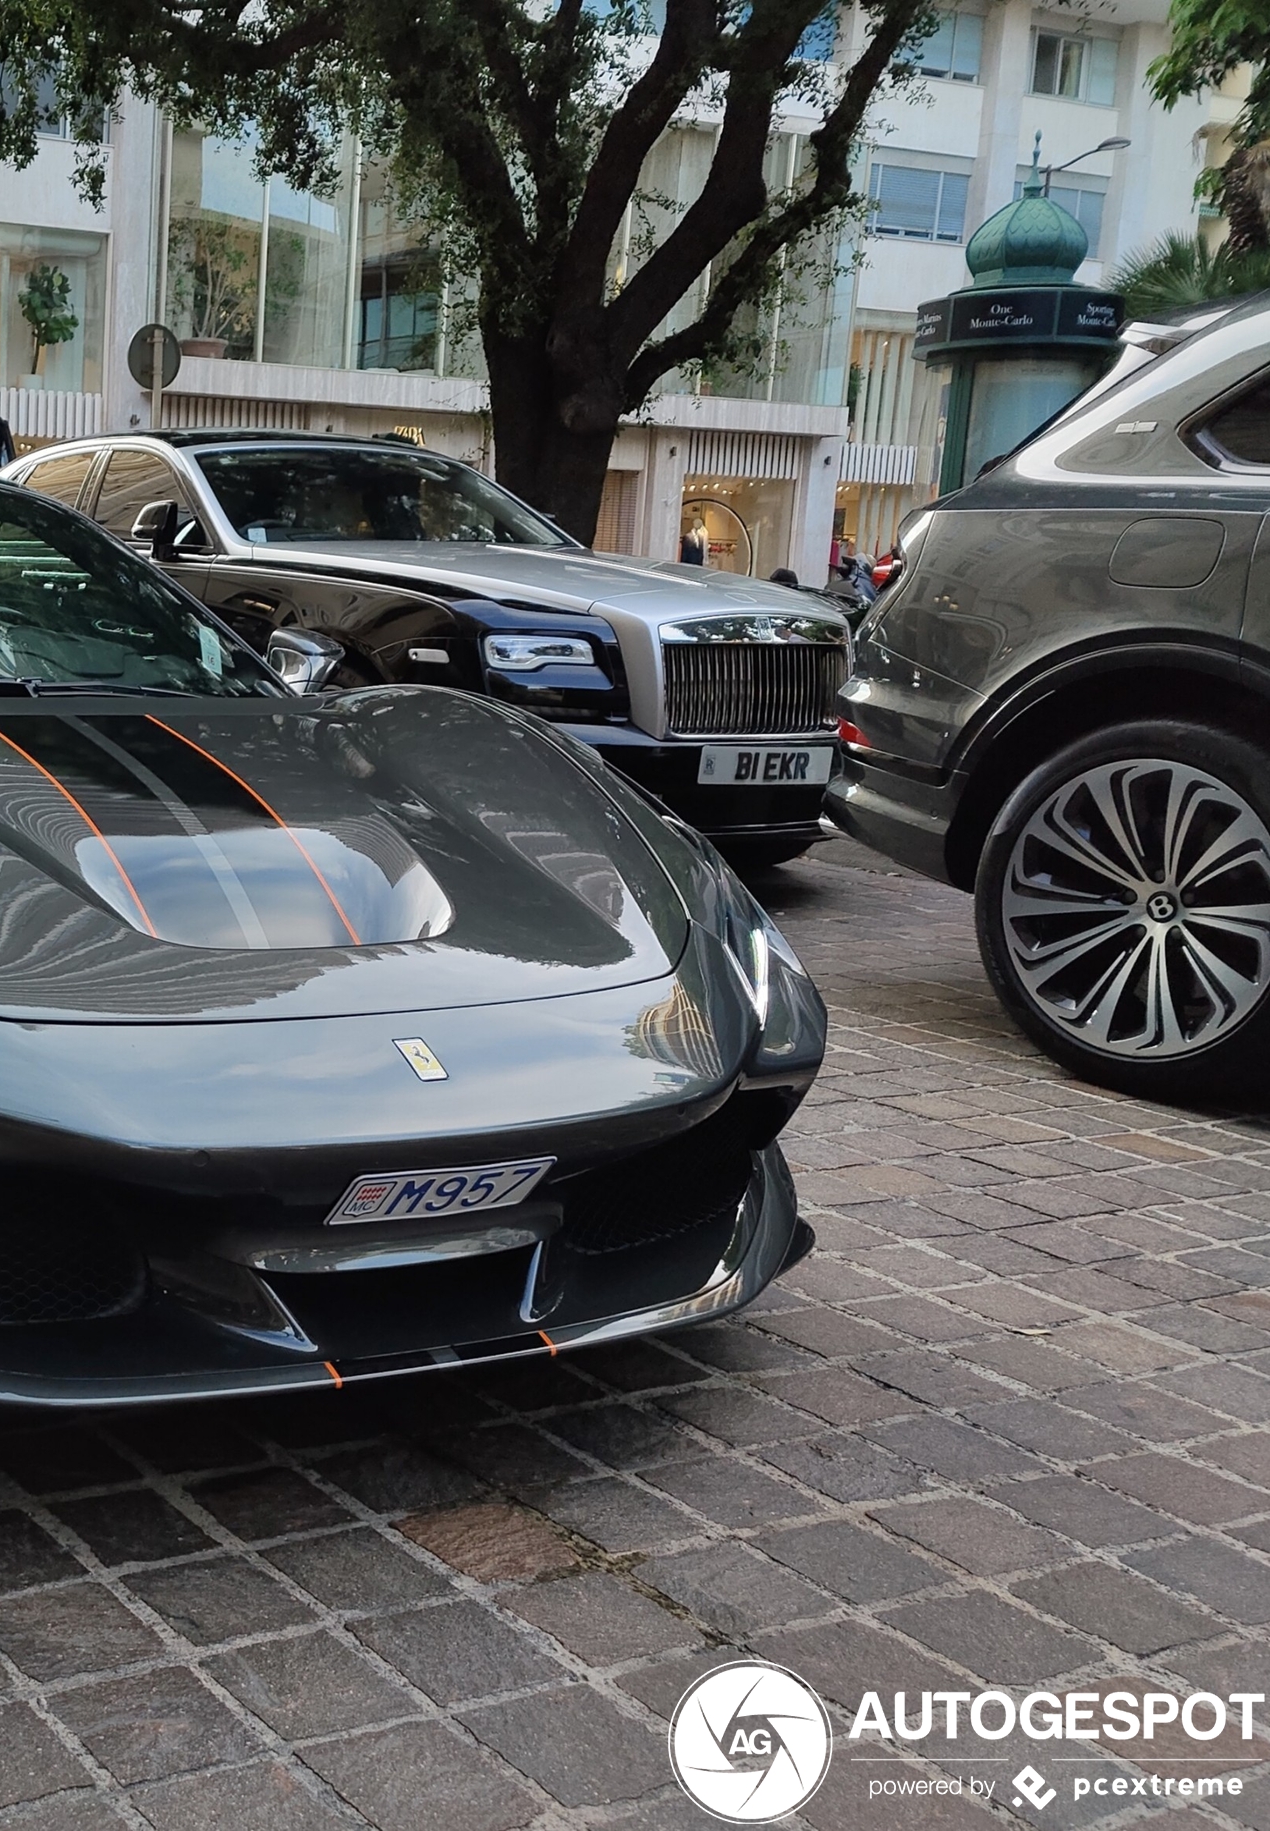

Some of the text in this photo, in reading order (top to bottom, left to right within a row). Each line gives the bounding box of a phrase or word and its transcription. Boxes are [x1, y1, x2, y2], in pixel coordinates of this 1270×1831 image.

[990, 303, 1013, 315] One
[1086, 302, 1115, 317] Sporting
[970, 314, 1033, 329] Monte-Carlo
[762, 752, 810, 780] EKR
[1148, 895, 1174, 919] B
[348, 1166, 542, 1215] MC M957
